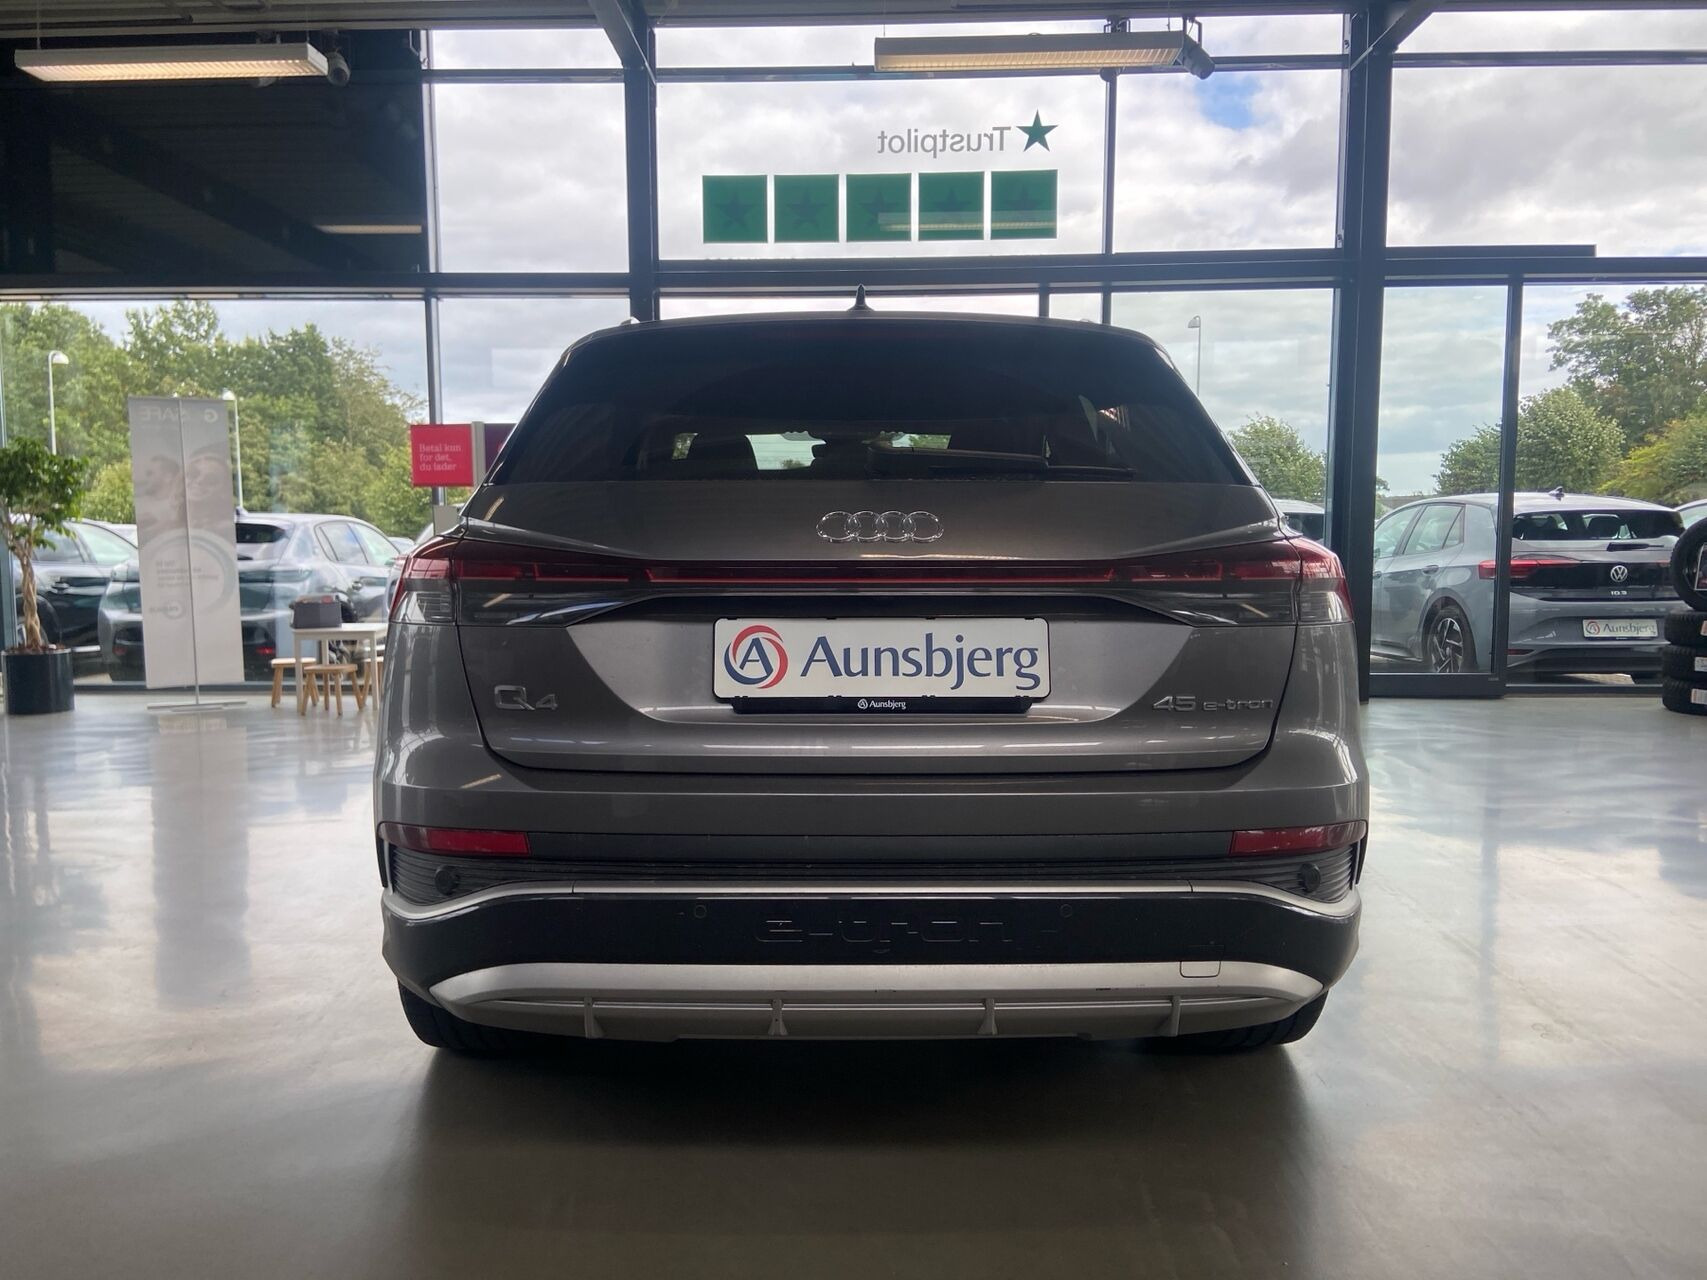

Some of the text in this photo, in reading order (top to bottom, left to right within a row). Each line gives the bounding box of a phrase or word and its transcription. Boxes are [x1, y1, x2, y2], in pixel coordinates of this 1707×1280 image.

[1603, 623, 1656, 636] Aunsbjerg
[800, 631, 1042, 691] Aunsbjerg
[869, 699, 907, 710] Aunsbjerg
[1153, 695, 1274, 712] 45 e-tron
